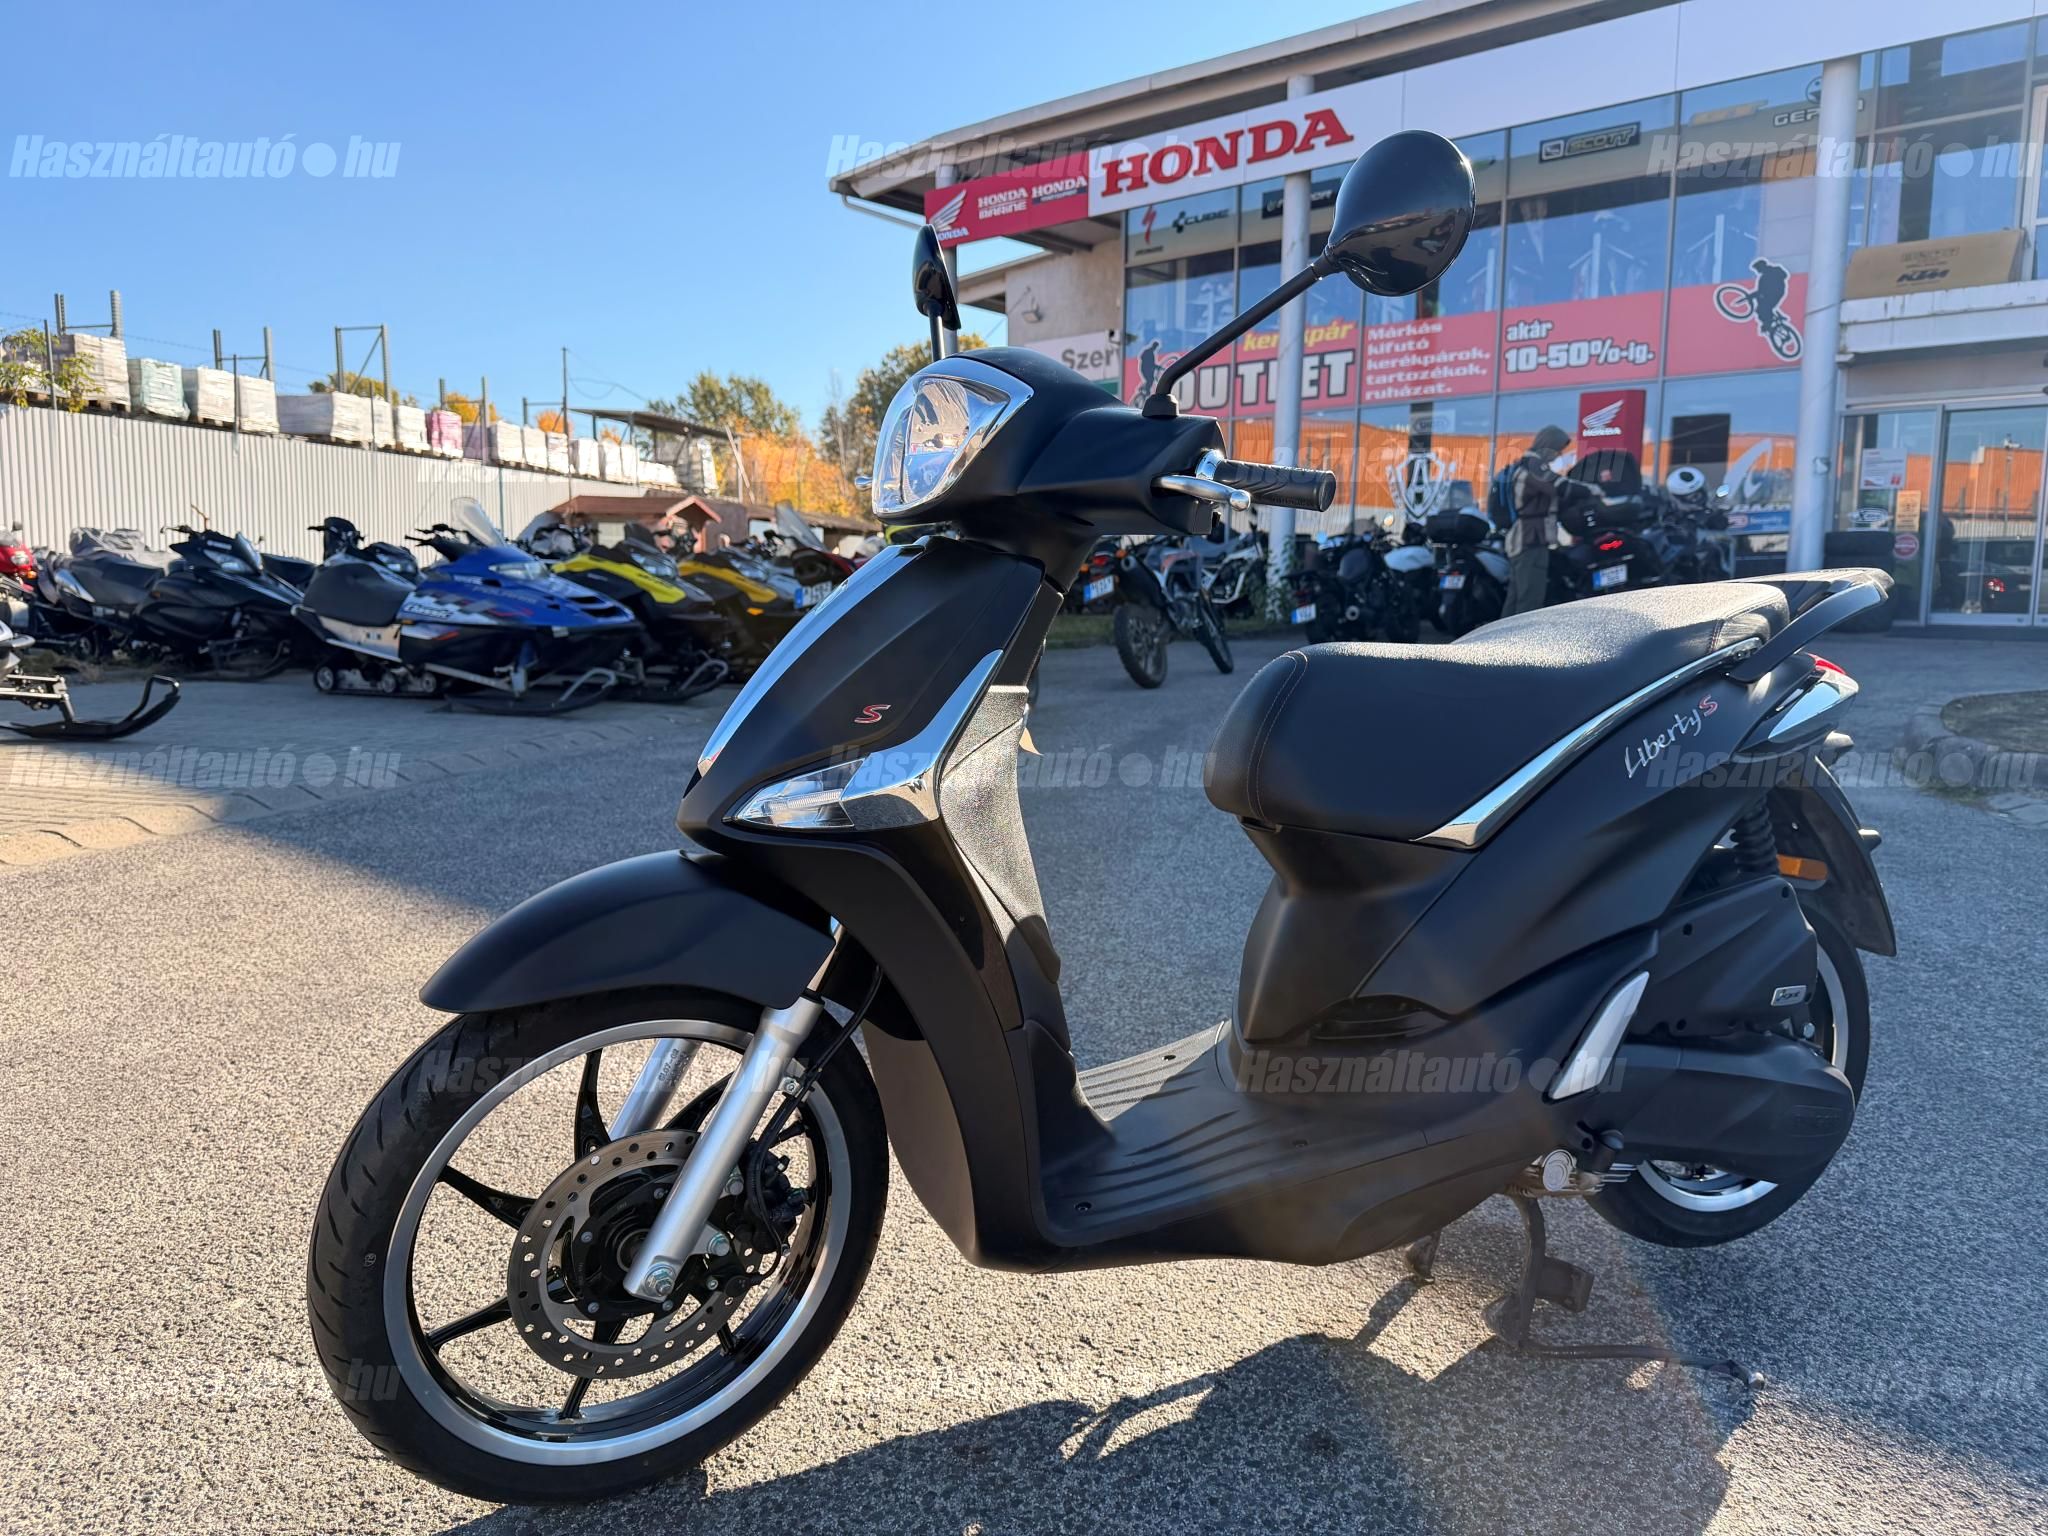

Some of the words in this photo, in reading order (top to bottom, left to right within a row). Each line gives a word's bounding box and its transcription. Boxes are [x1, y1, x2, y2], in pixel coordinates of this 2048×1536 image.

[1101, 108, 1354, 198] HONDA
[1032, 175, 1087, 198] HONDA
[978, 187, 1027, 208] HONDA
[937, 227, 969, 241] ONDA
[1244, 320, 1355, 351] kerpár
[1367, 322, 1443, 341] Márkás
[1506, 321, 1552, 342] akár
[1367, 338, 1430, 356] kifutó
[854, 704, 891, 724] S
[1624, 709, 1701, 779] Liberty
